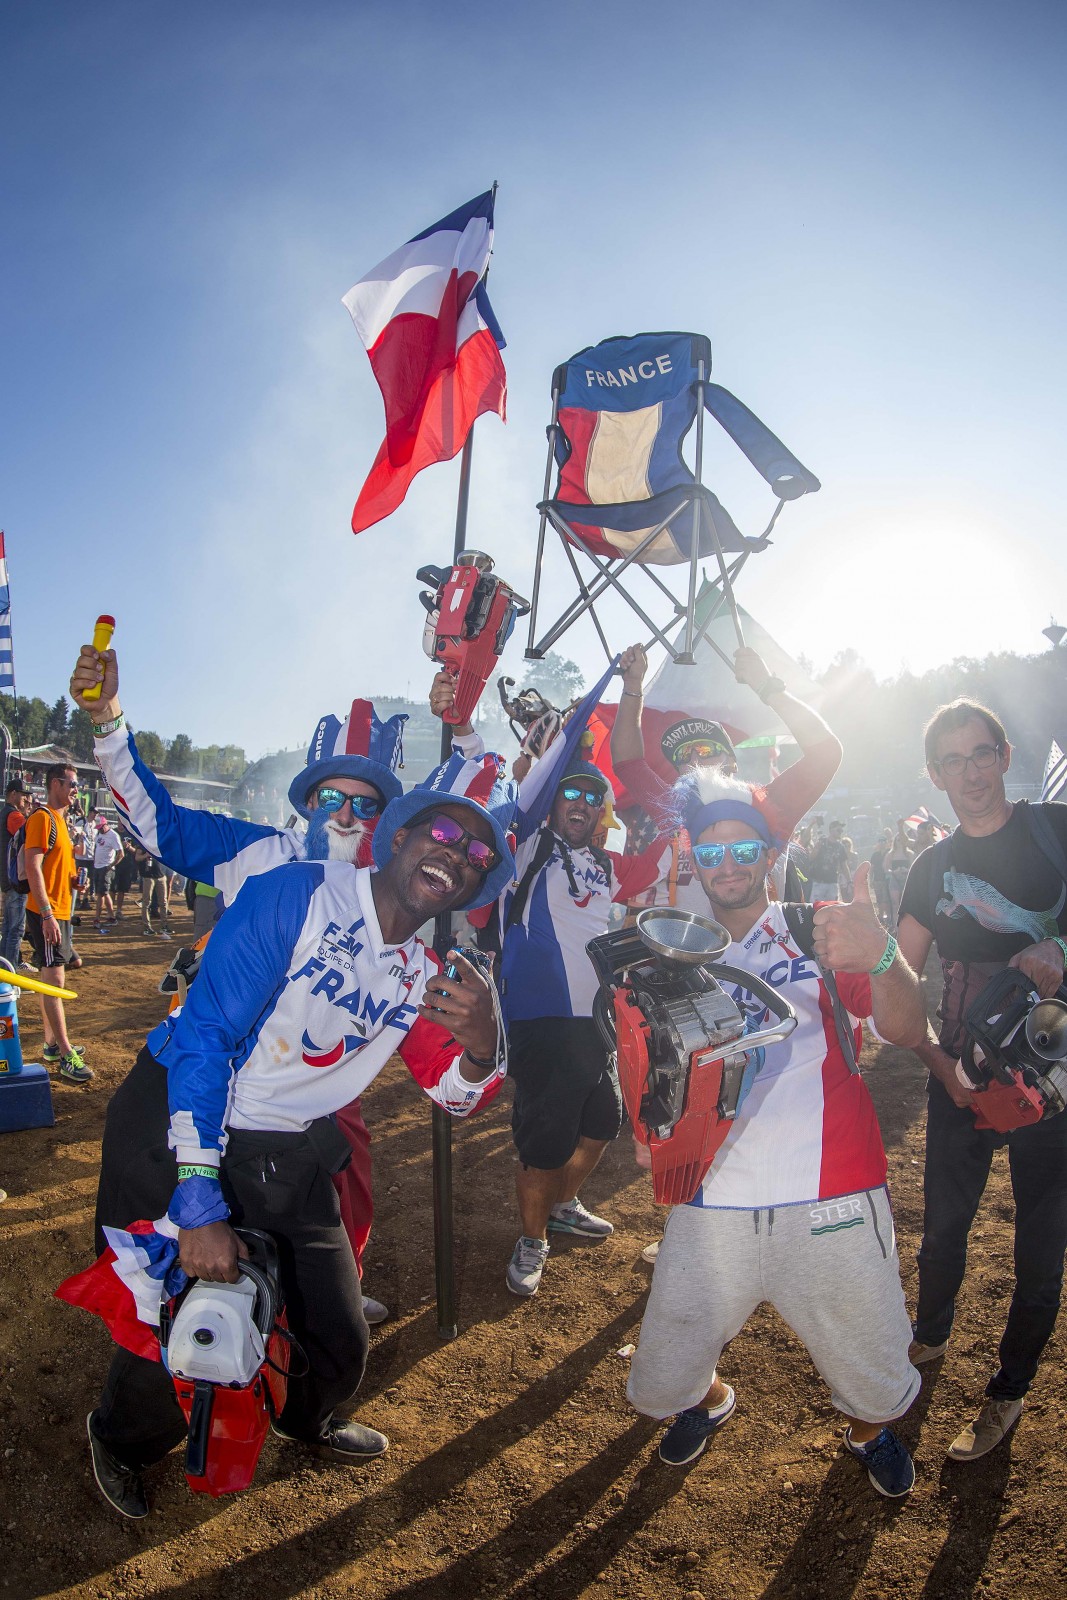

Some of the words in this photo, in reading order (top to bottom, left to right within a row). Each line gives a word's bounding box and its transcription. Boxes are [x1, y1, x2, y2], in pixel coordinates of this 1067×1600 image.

[585, 353, 673, 388] FRANCE
[315, 721, 327, 761] ance
[662, 725, 689, 748] SANTA
[687, 722, 715, 735] CRUZ
[430, 761, 450, 791] ance
[809, 1198, 863, 1225] STER
